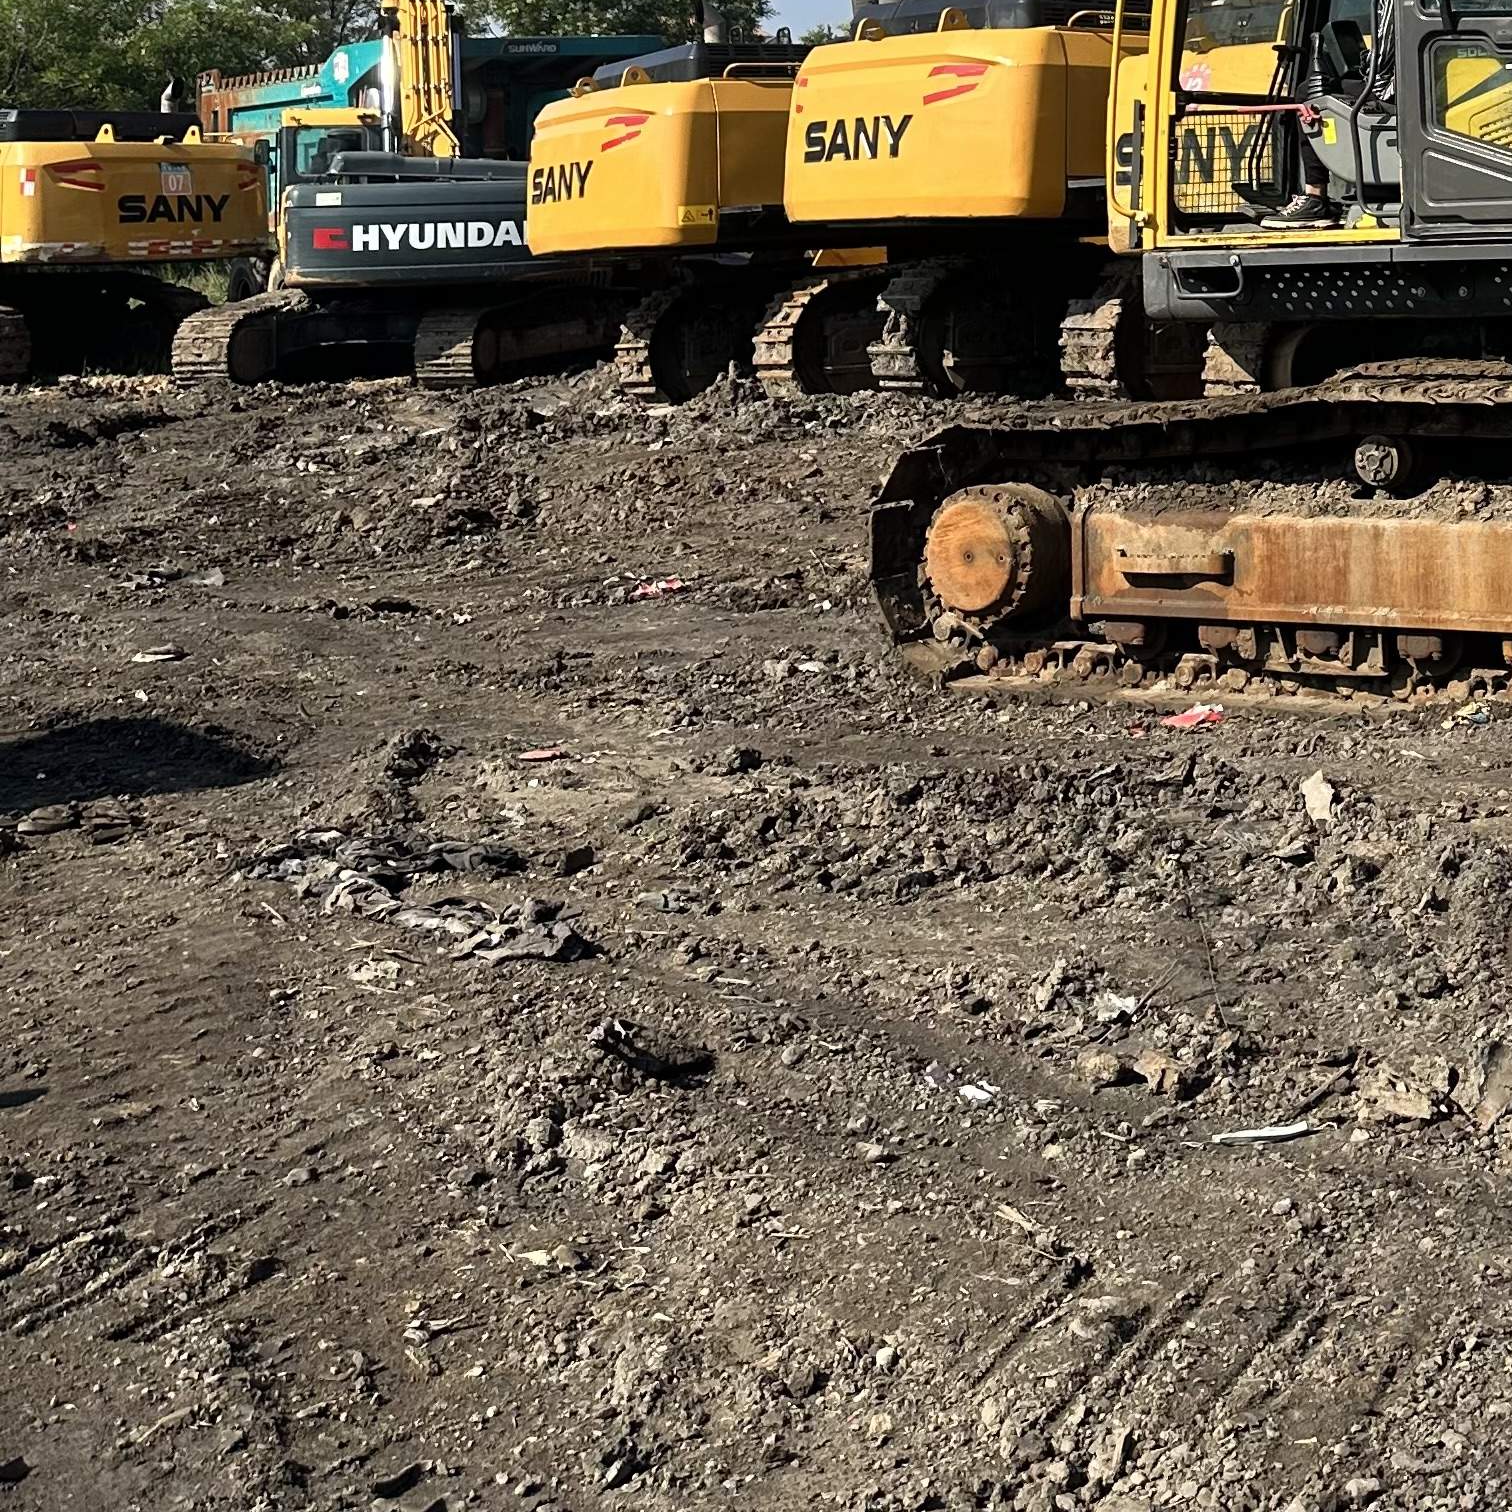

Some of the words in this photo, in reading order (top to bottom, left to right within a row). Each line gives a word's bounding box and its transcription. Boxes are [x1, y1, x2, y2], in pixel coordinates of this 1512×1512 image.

[1457, 48, 1488, 58] SDL
[804, 114, 914, 164] SANY
[1116, 124, 1261, 186] SNY
[532, 160, 594, 205] SANY
[117, 194, 231, 223] SANY
